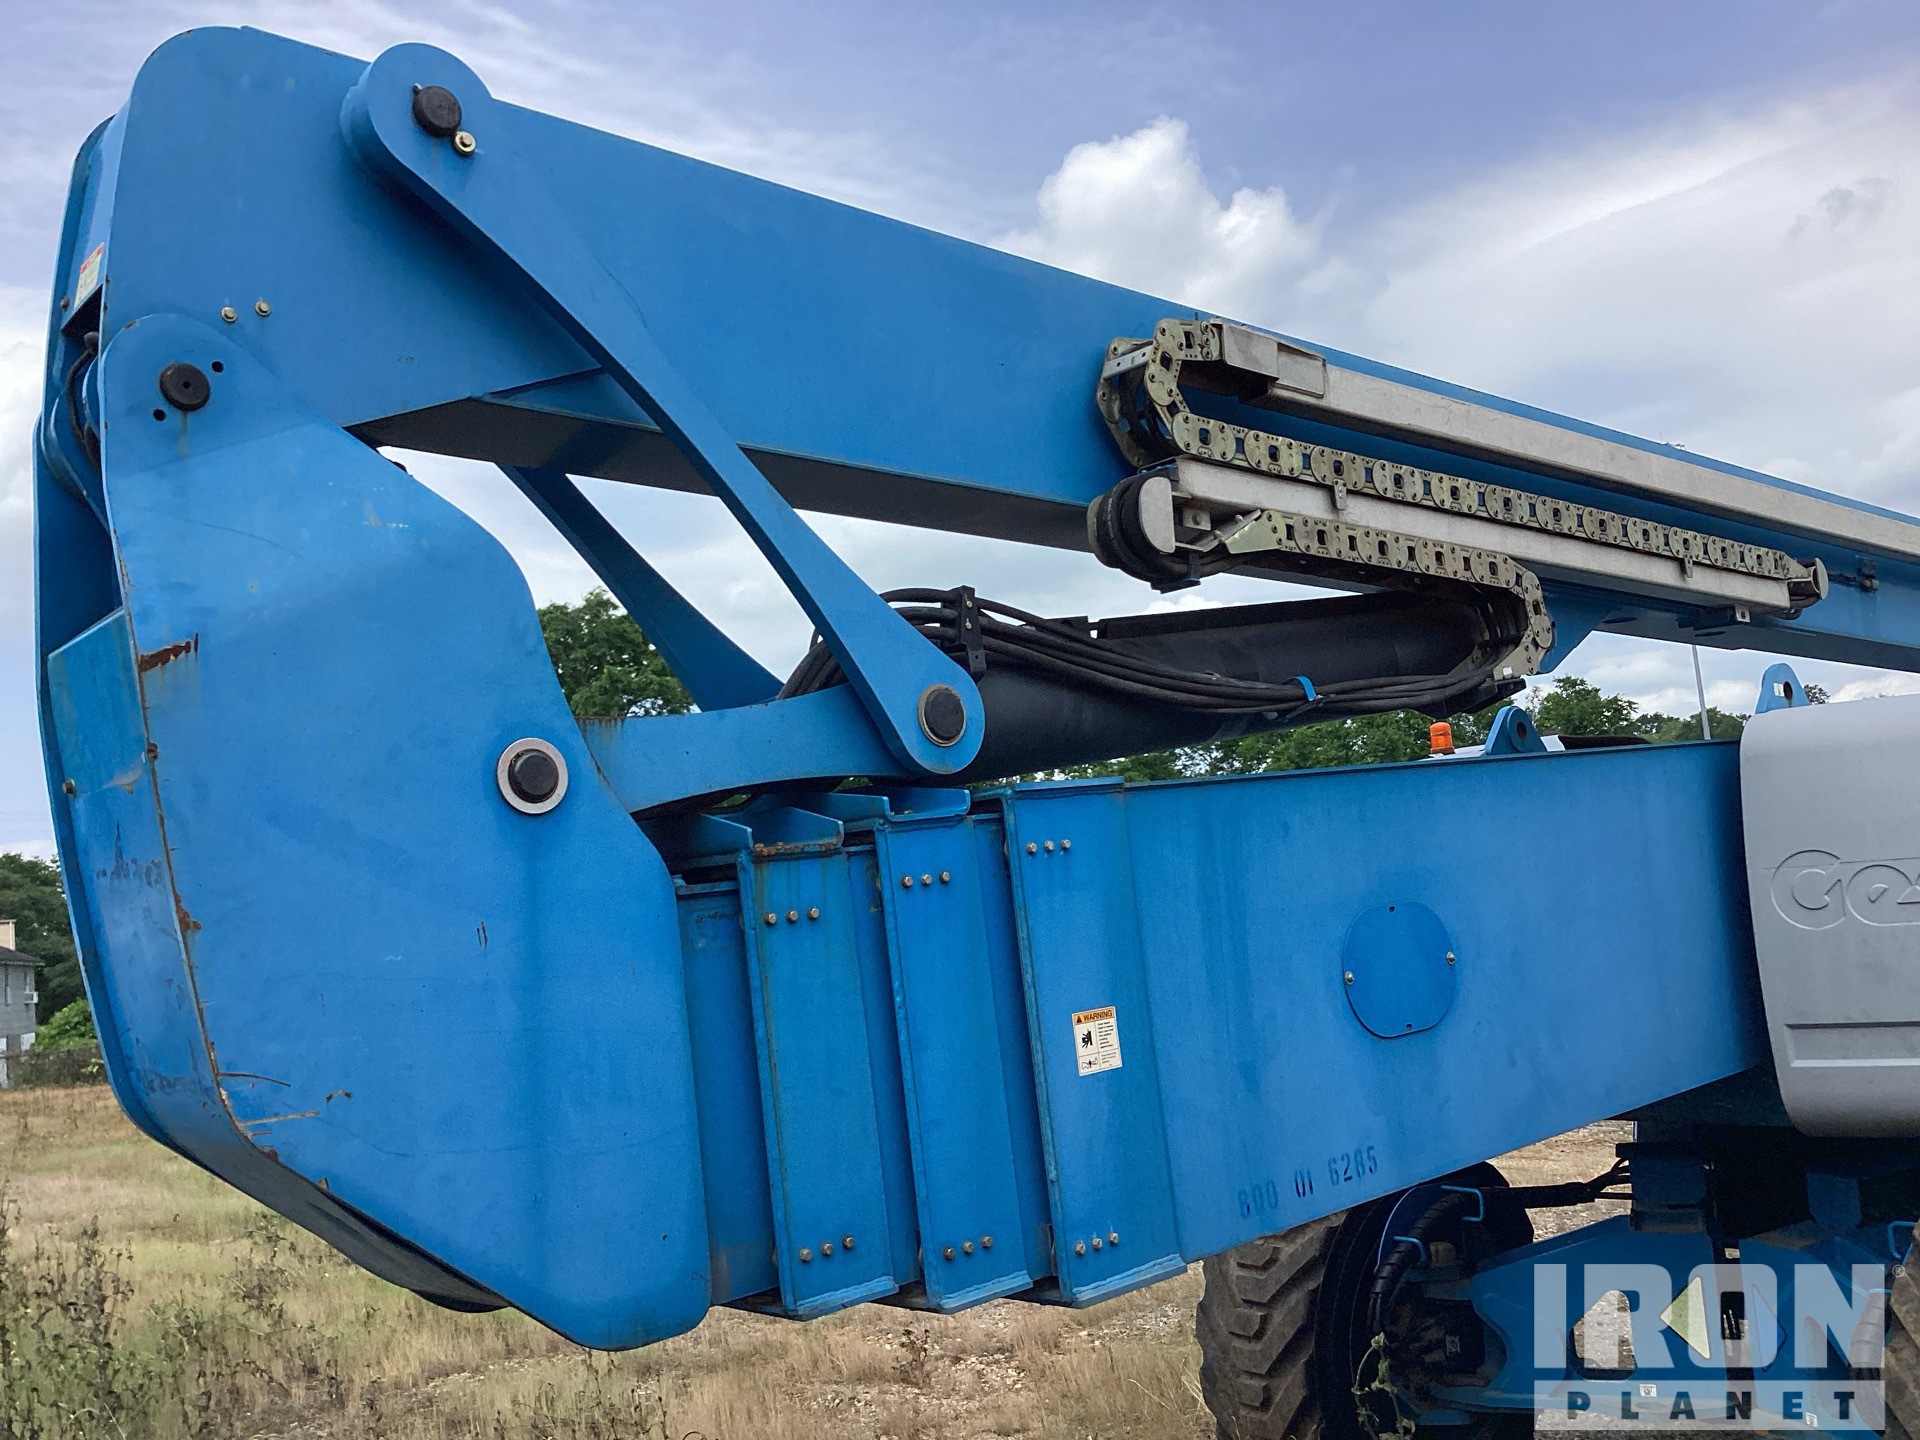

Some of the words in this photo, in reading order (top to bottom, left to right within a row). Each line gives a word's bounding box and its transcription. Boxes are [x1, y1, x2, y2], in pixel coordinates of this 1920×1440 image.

[1083, 1010, 1113, 1022] WARNING
[1237, 1179, 1278, 1219] 800
[1328, 1146, 1378, 1186] 6285
